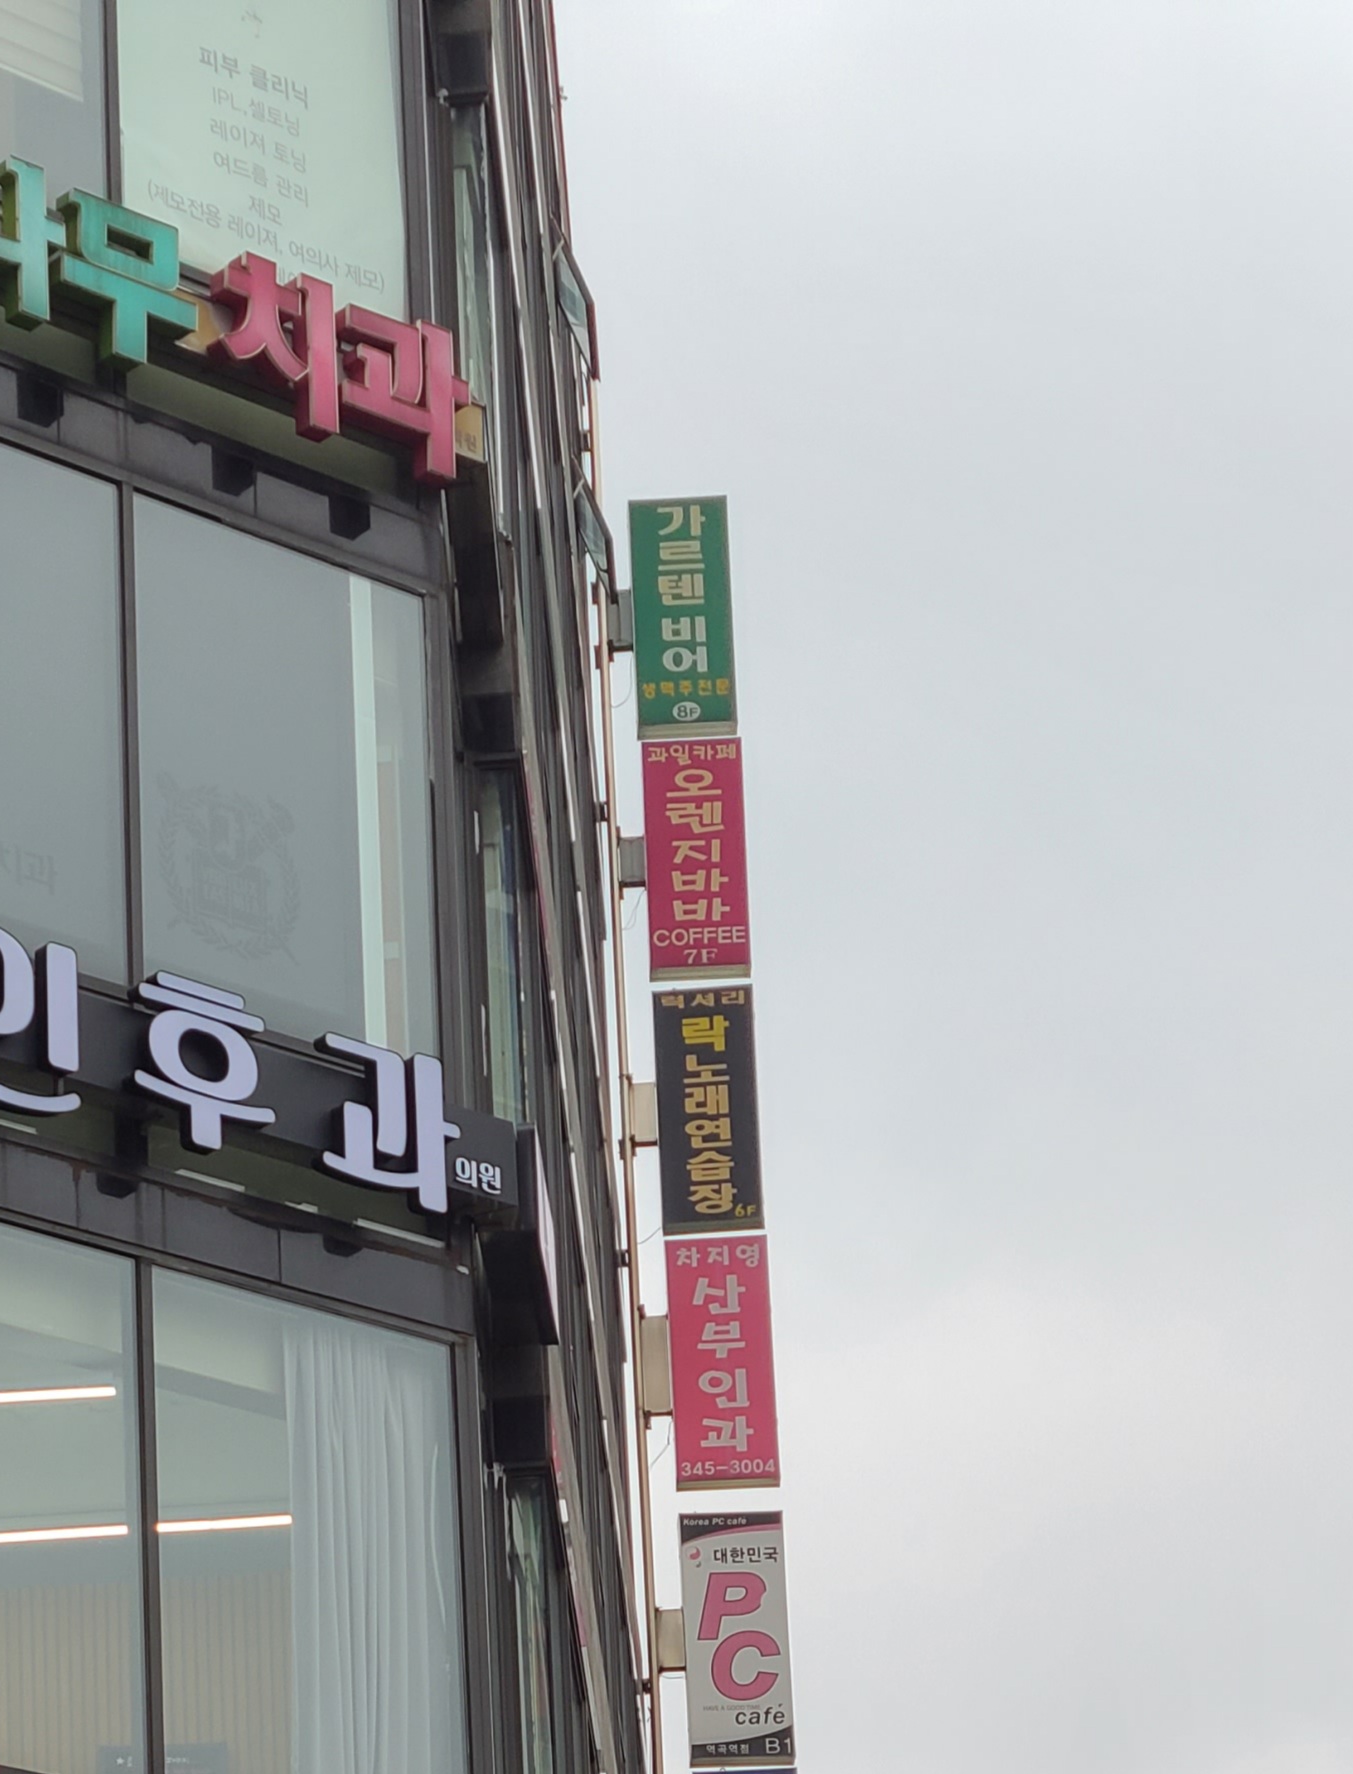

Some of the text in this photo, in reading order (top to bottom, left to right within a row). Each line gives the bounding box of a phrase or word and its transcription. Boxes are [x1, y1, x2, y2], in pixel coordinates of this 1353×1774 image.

[198, 46, 309, 110] 피부 클리닉
[275, 175, 309, 208] 관리
[207, 252, 472, 482] 치과
[676, 704, 699, 719] 8F
[648, 743, 736, 766] 과일카페
[653, 926, 746, 947] COFFEE
[683, 949, 718, 964] 7F
[660, 990, 745, 1009] 럭셔리
[683, 1054, 738, 1214] 노래연습장
[454, 1155, 502, 1197] 의원
[735, 1203, 756, 1217] 6F
[676, 1244, 760, 1268] 차지영
[692, 1274, 755, 1452] 산부인과
[681, 1459, 776, 1477] 345-3004
[683, 1517, 709, 1526] Korea
[712, 1517, 725, 1525] PC
[713, 1547, 779, 1564] 대한민국
[697, 1571, 781, 1701] PC
[735, 1703, 785, 1725] café
[706, 1743, 750, 1755] 역곡역점
[765, 1738, 792, 1755] B1
